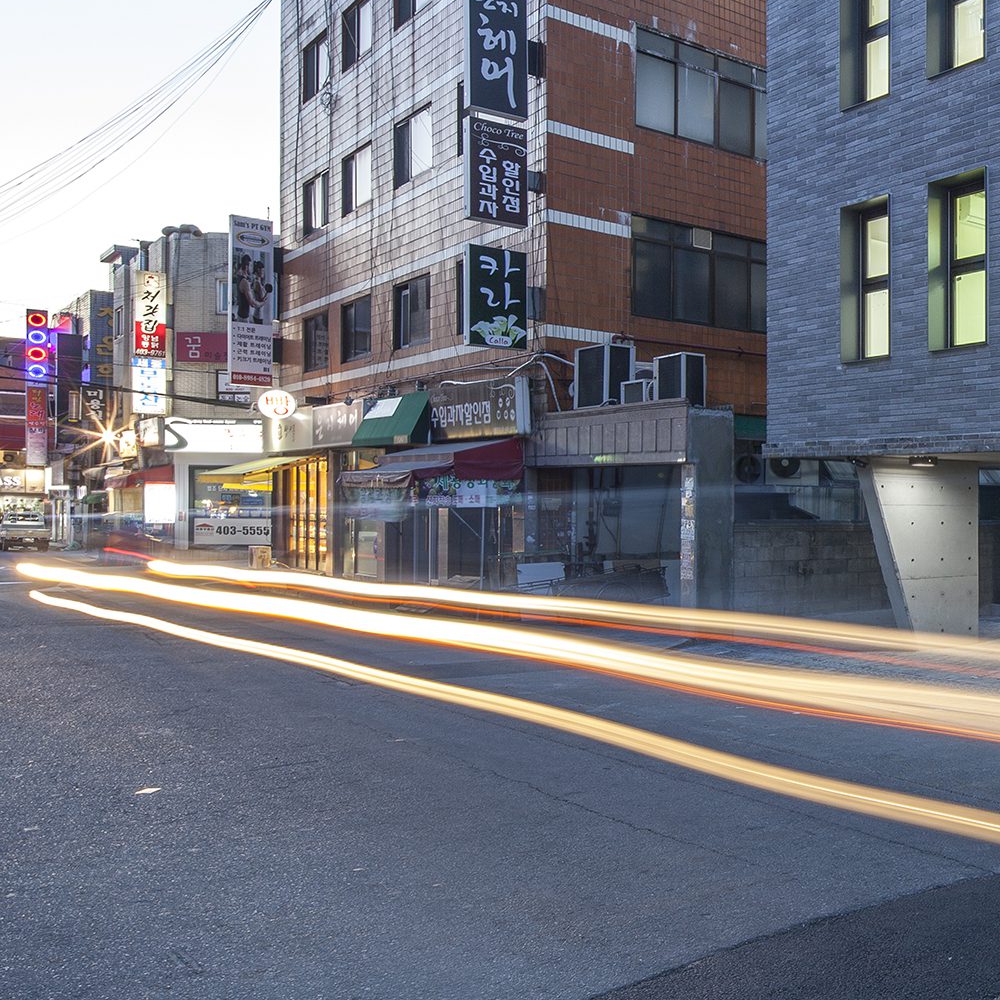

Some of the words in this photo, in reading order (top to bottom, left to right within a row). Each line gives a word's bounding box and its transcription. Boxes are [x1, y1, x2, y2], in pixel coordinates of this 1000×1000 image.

[473, 121, 504, 136] Choco
[504, 127, 525, 141] Tree
[478, 148, 498, 218] 수입과자
[502, 159, 521, 215] 할인점
[251, 222, 259, 231] PT
[479, 250, 521, 310] 카라
[141, 290, 161, 333] 처갓집
[184, 336, 202, 360] 꿈
[251, 342, 272, 350] 트레이닝
[431, 400, 492, 428] 수입과자할인점
[215, 525, 271, 537] 403-5555
